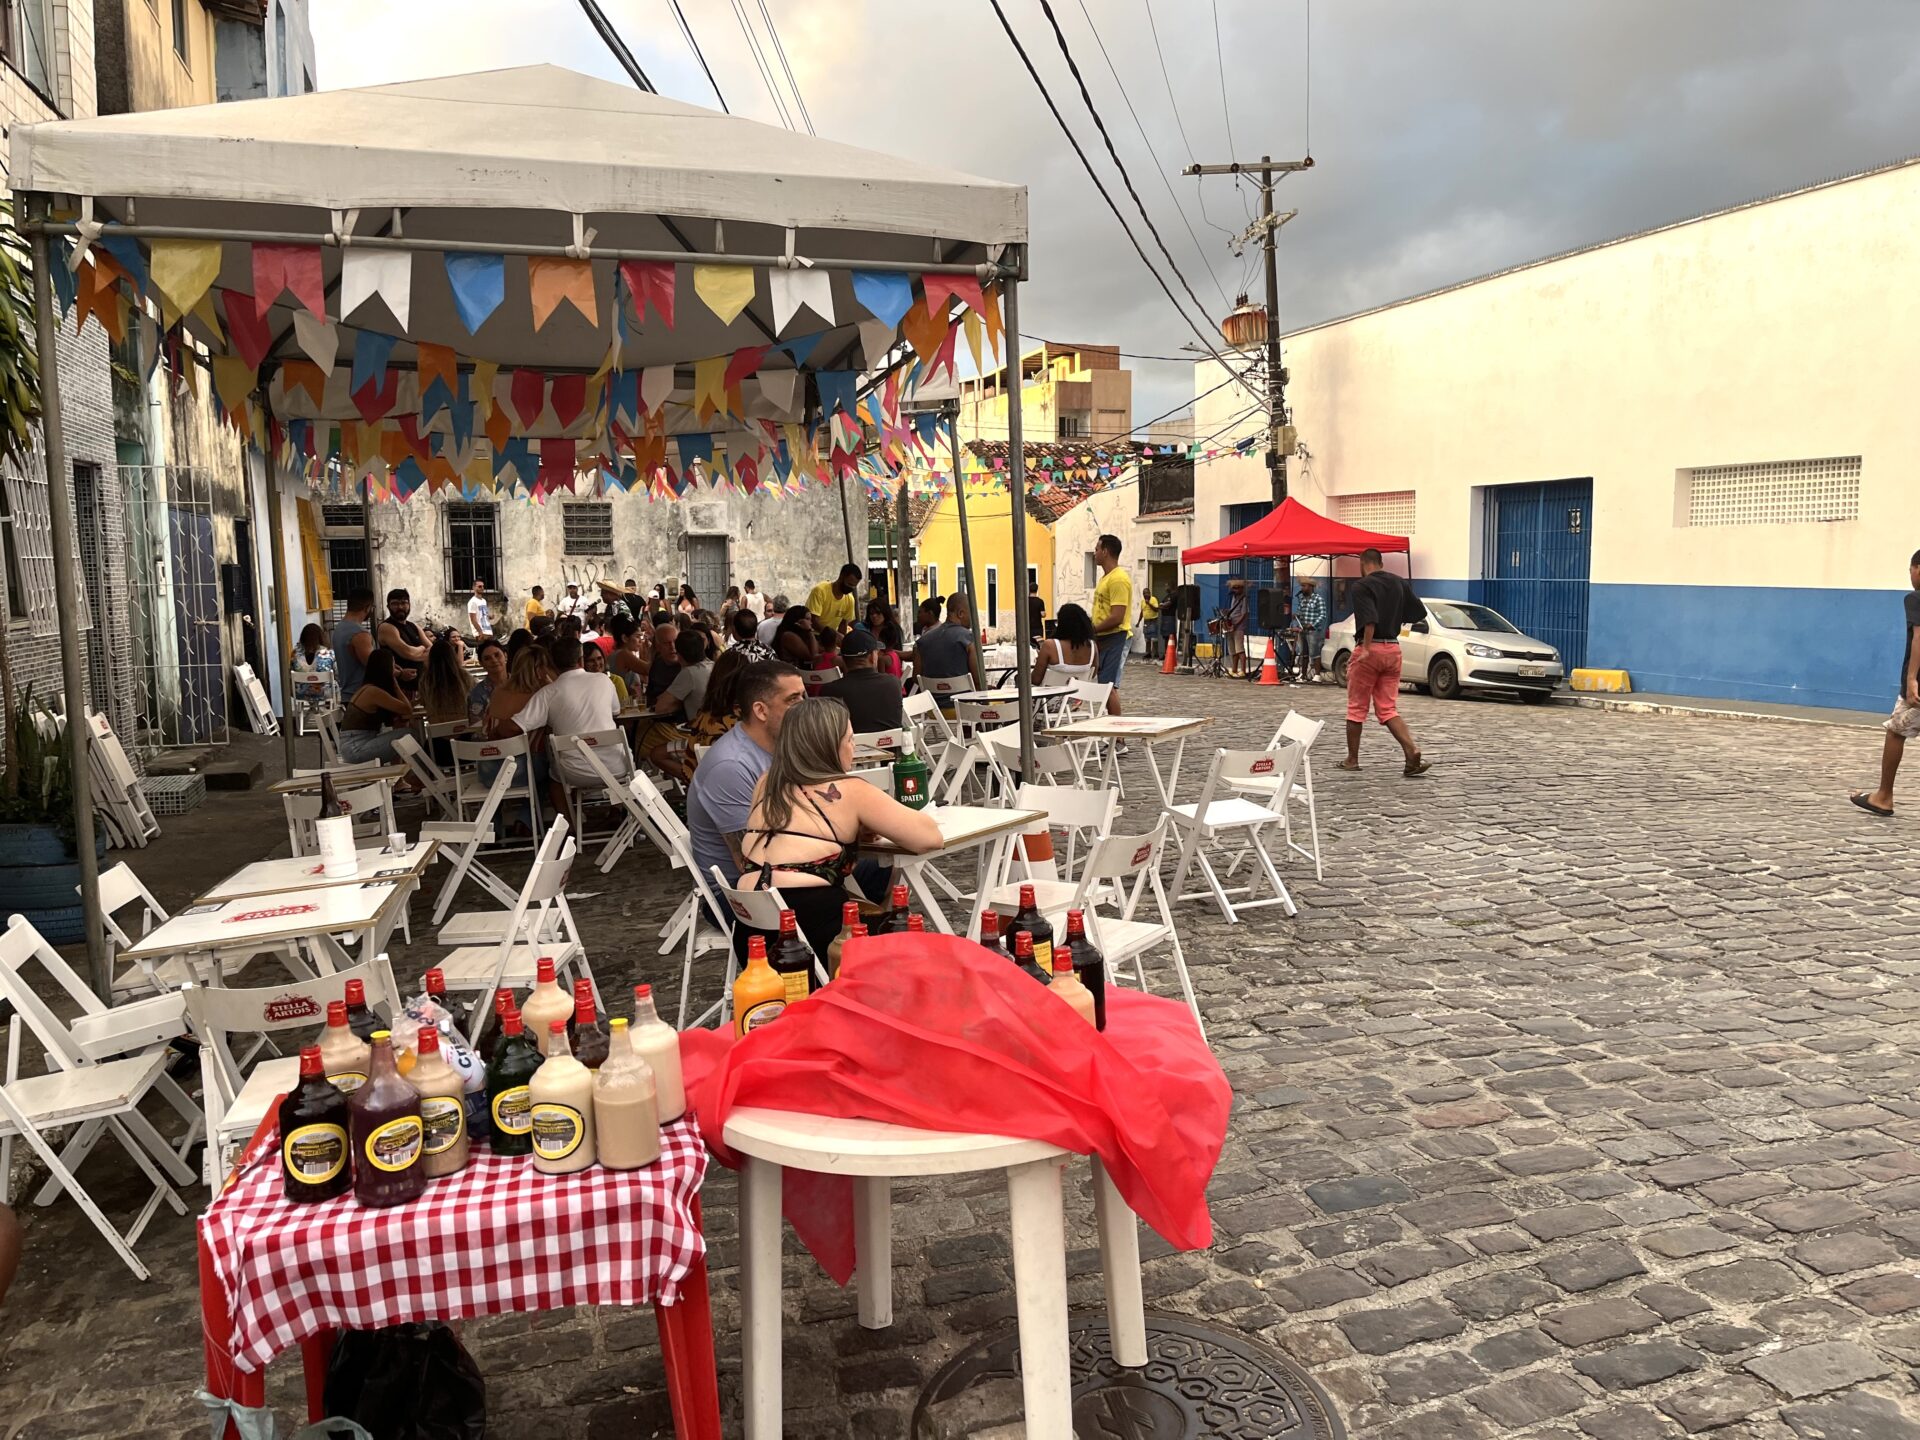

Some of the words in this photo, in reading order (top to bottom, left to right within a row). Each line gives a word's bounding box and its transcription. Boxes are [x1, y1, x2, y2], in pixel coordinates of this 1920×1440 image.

[900, 794, 924, 803] SPATEN
[271, 1001, 309, 1012] STELLA
[274, 1007, 311, 1018] ARTOIS
